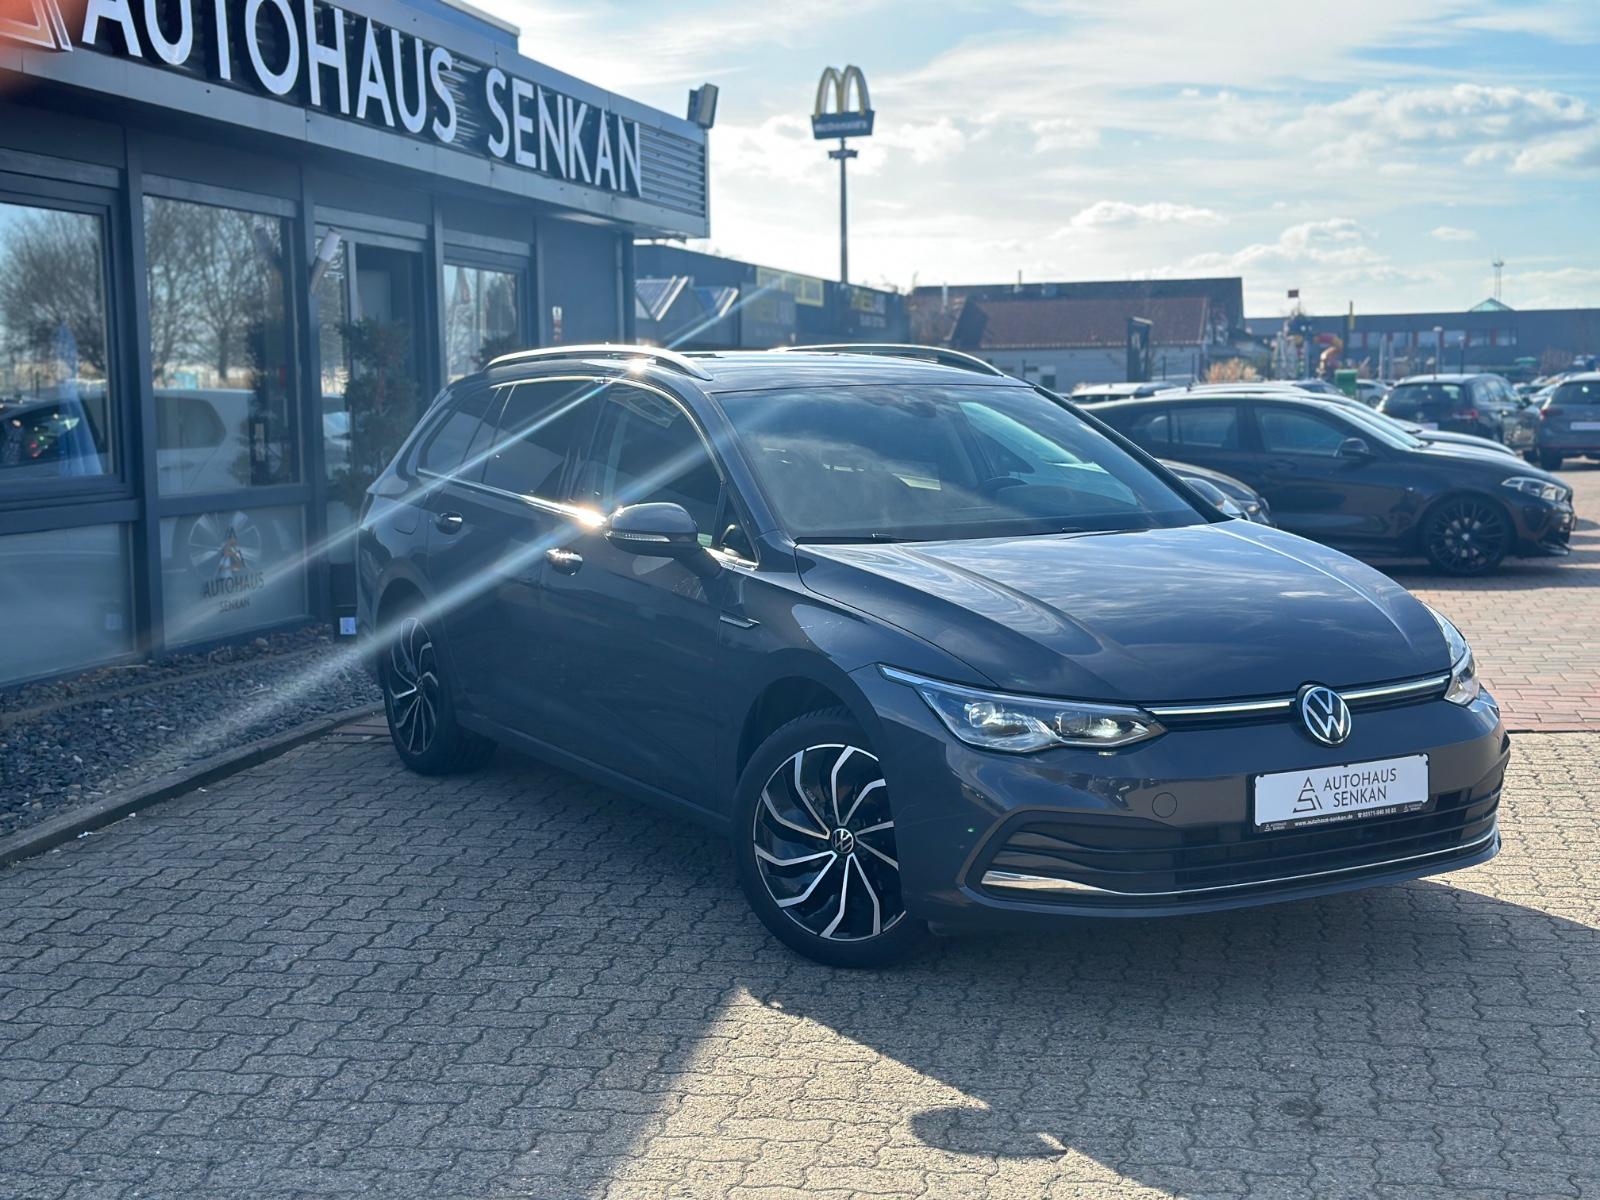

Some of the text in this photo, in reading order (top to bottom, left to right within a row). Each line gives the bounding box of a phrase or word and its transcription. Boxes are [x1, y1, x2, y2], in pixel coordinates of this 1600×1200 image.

[486, 67, 643, 198] SENKAN
[203, 572, 265, 598] AUTOHAUS
[219, 598, 250, 614] SENKAN
[1323, 768, 1397, 792] AUTOHAUS
[1333, 785, 1387, 808] SENKAN
